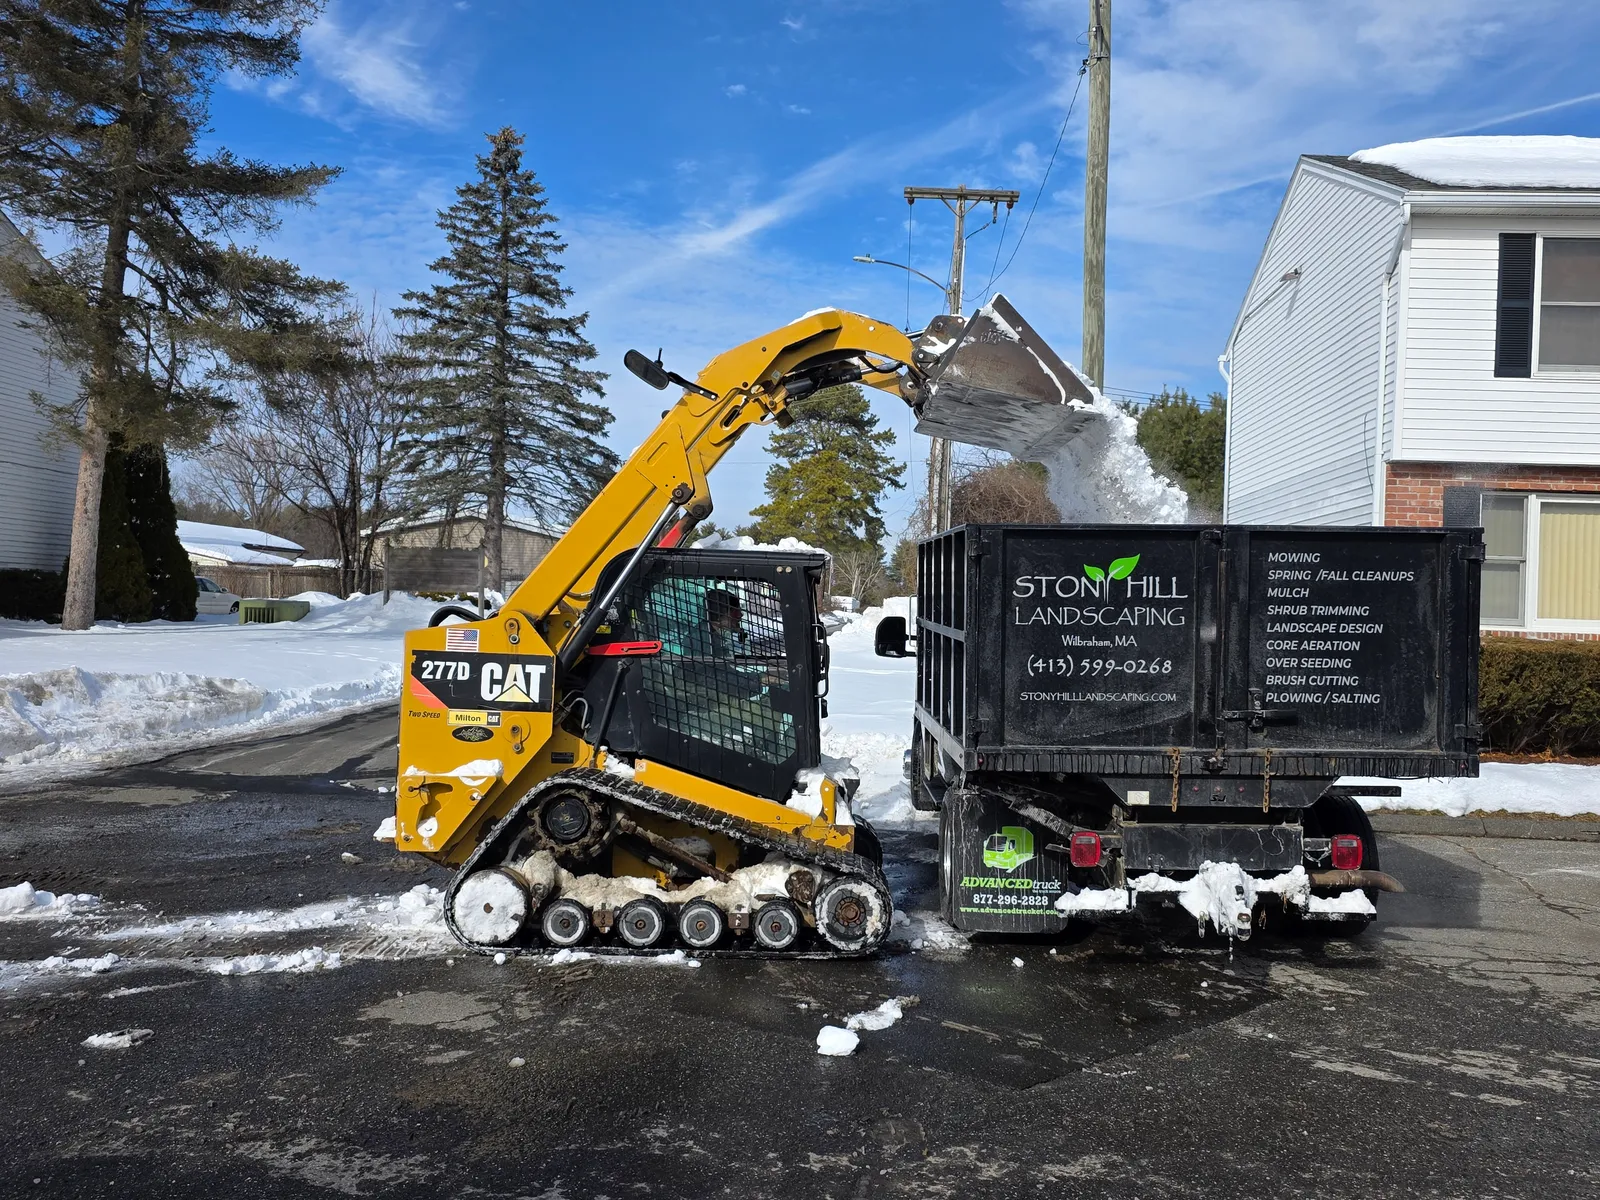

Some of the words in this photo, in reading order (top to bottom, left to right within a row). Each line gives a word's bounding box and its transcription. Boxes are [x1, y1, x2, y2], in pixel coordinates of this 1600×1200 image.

[1268, 553, 1320, 563] MOWING
[1268, 570, 1311, 580] SPRING
[1352, 571, 1414, 582] CLEANUPS
[1127, 576, 1188, 598] HILL
[1267, 588, 1309, 598] MULCH
[1267, 605, 1307, 616] SHRUB
[1311, 606, 1370, 616] TRIMMING
[1015, 607, 1185, 626] LANDSCAPING
[1267, 623, 1336, 633] LANDSCAPE
[1339, 624, 1383, 634] DESIGN
[1062, 635, 1113, 648] Wilbraham,
[1115, 636, 1137, 647] MA
[1266, 640, 1298, 651] CORE
[1300, 641, 1360, 651] AERATION
[1028, 655, 1074, 677] (413)
[1080, 658, 1172, 677] 599-0268
[1266, 658, 1298, 668] OVER
[1300, 658, 1352, 669] SEEDING
[421, 660, 470, 681] 277D
[480, 662, 547, 703] CAT
[1266, 676, 1306, 686] BRUSH
[1309, 676, 1359, 686] CUTTING
[1265, 693, 1322, 704] PLOWING
[1331, 694, 1381, 704] SALTING
[408, 710, 422, 718] TWO
[422, 711, 441, 719] SPEED
[455, 714, 481, 722] Milton
[487, 715, 499, 723] CAT
[973, 893, 1049, 906] 877-296-2828
